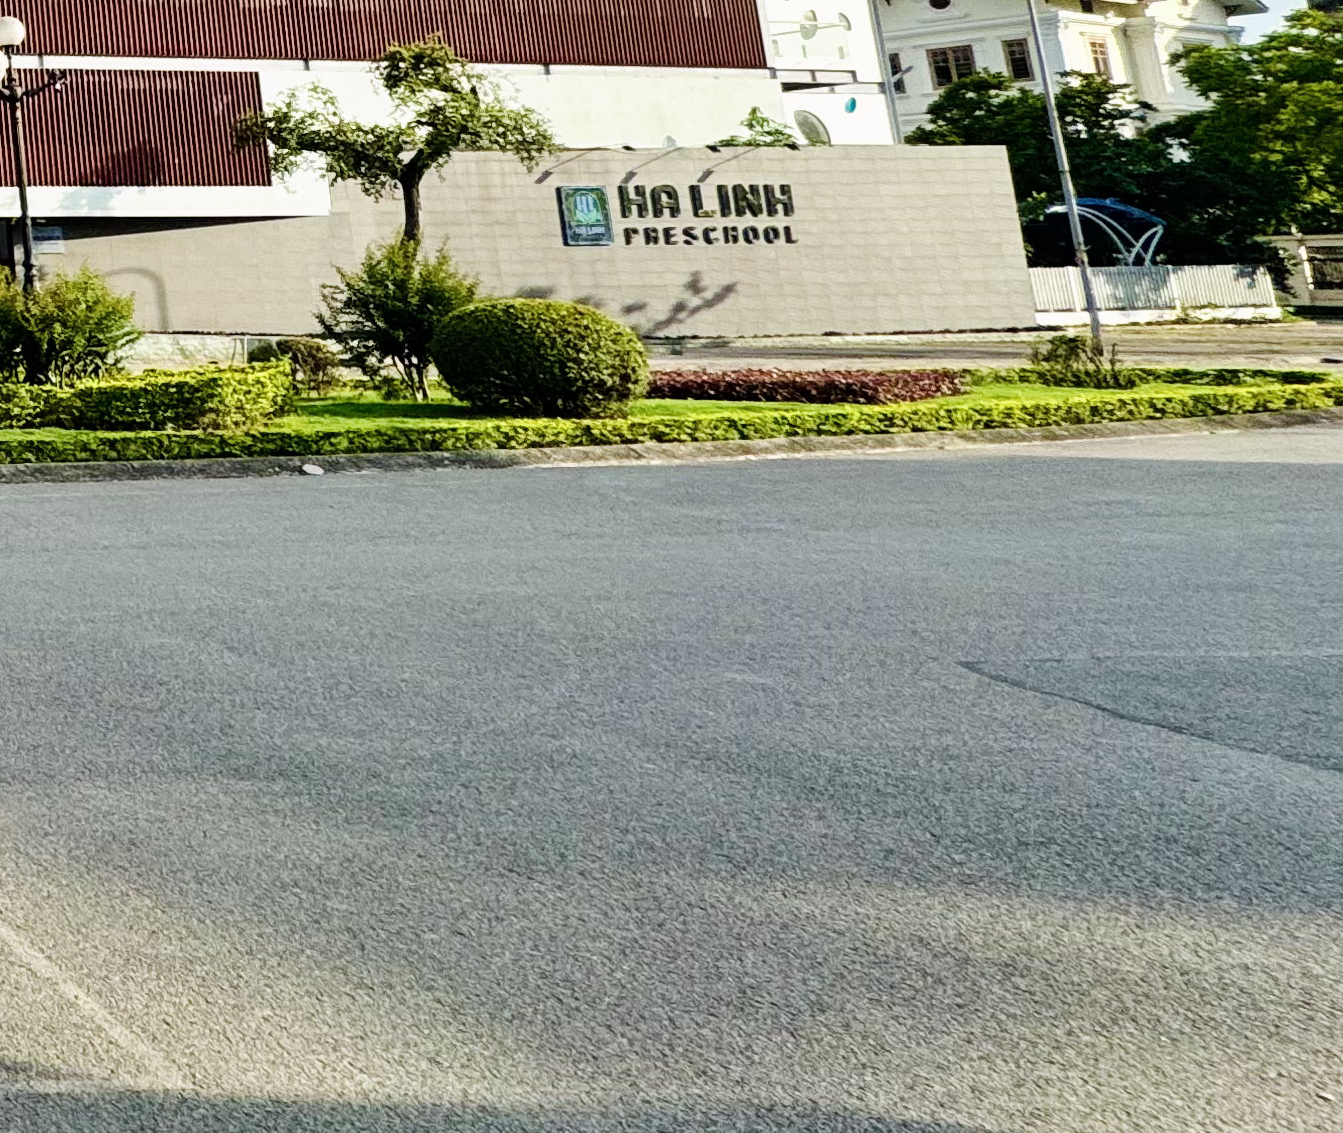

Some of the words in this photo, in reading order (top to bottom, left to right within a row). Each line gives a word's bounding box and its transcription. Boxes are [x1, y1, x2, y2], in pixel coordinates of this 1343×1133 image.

[617, 184, 681, 218] HA
[688, 183, 795, 218] LINH
[623, 225, 799, 246] PRESCHOOL
